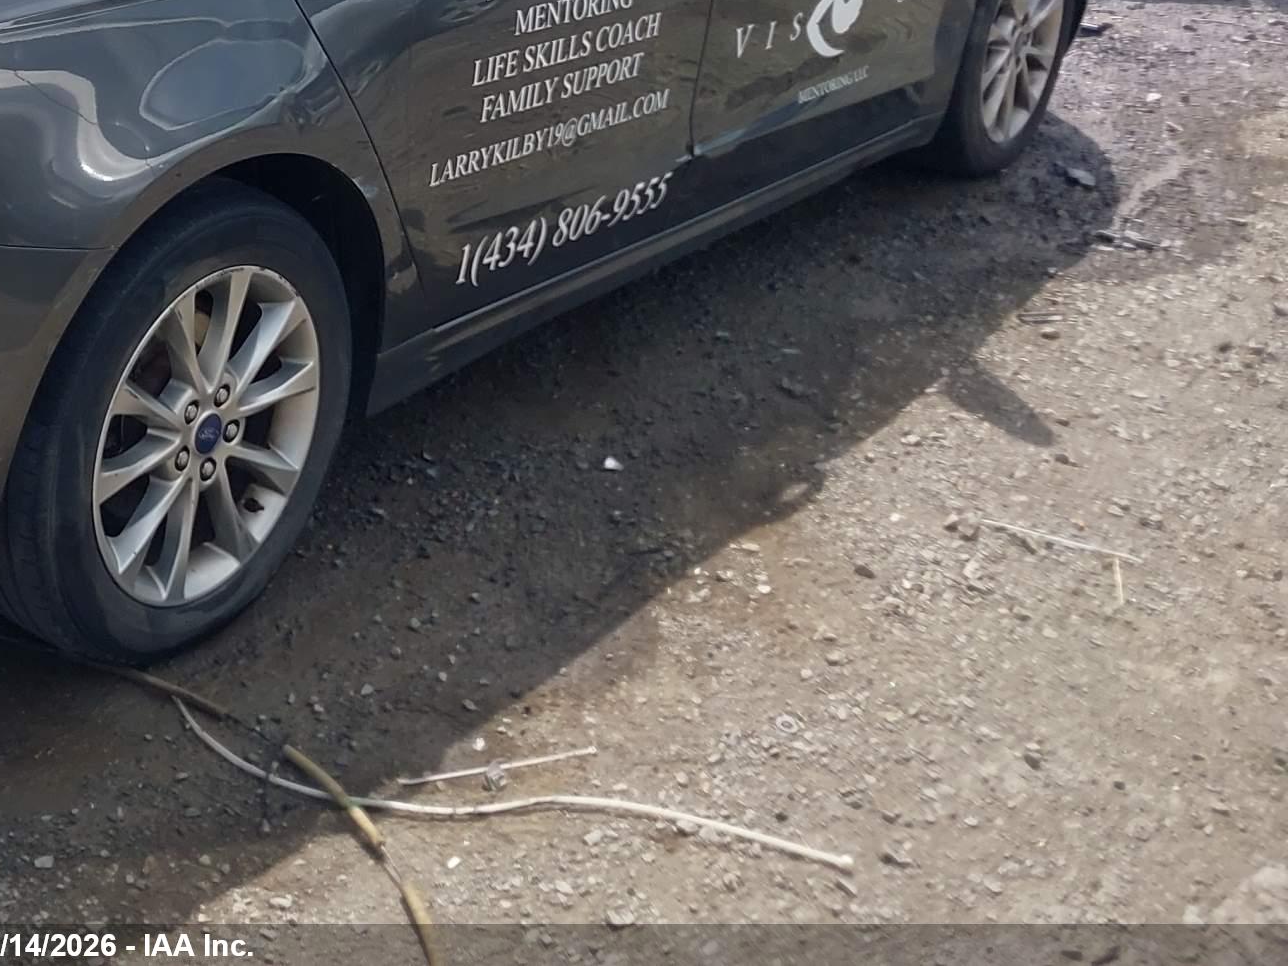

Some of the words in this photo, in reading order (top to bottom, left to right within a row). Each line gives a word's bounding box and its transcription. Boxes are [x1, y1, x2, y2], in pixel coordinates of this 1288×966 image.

[471, 49, 520, 87] LIFE
[522, 34, 593, 74] SKILLS
[596, 12, 662, 52] COACH
[479, 77, 559, 123] FAMILY
[560, 52, 645, 100] SUPPORT
[428, 88, 670, 188] LARRYKILBY19@GMAIL.COM
[456, 216, 547, 287] 1(434)
[552, 172, 674, 249] 806-9555
